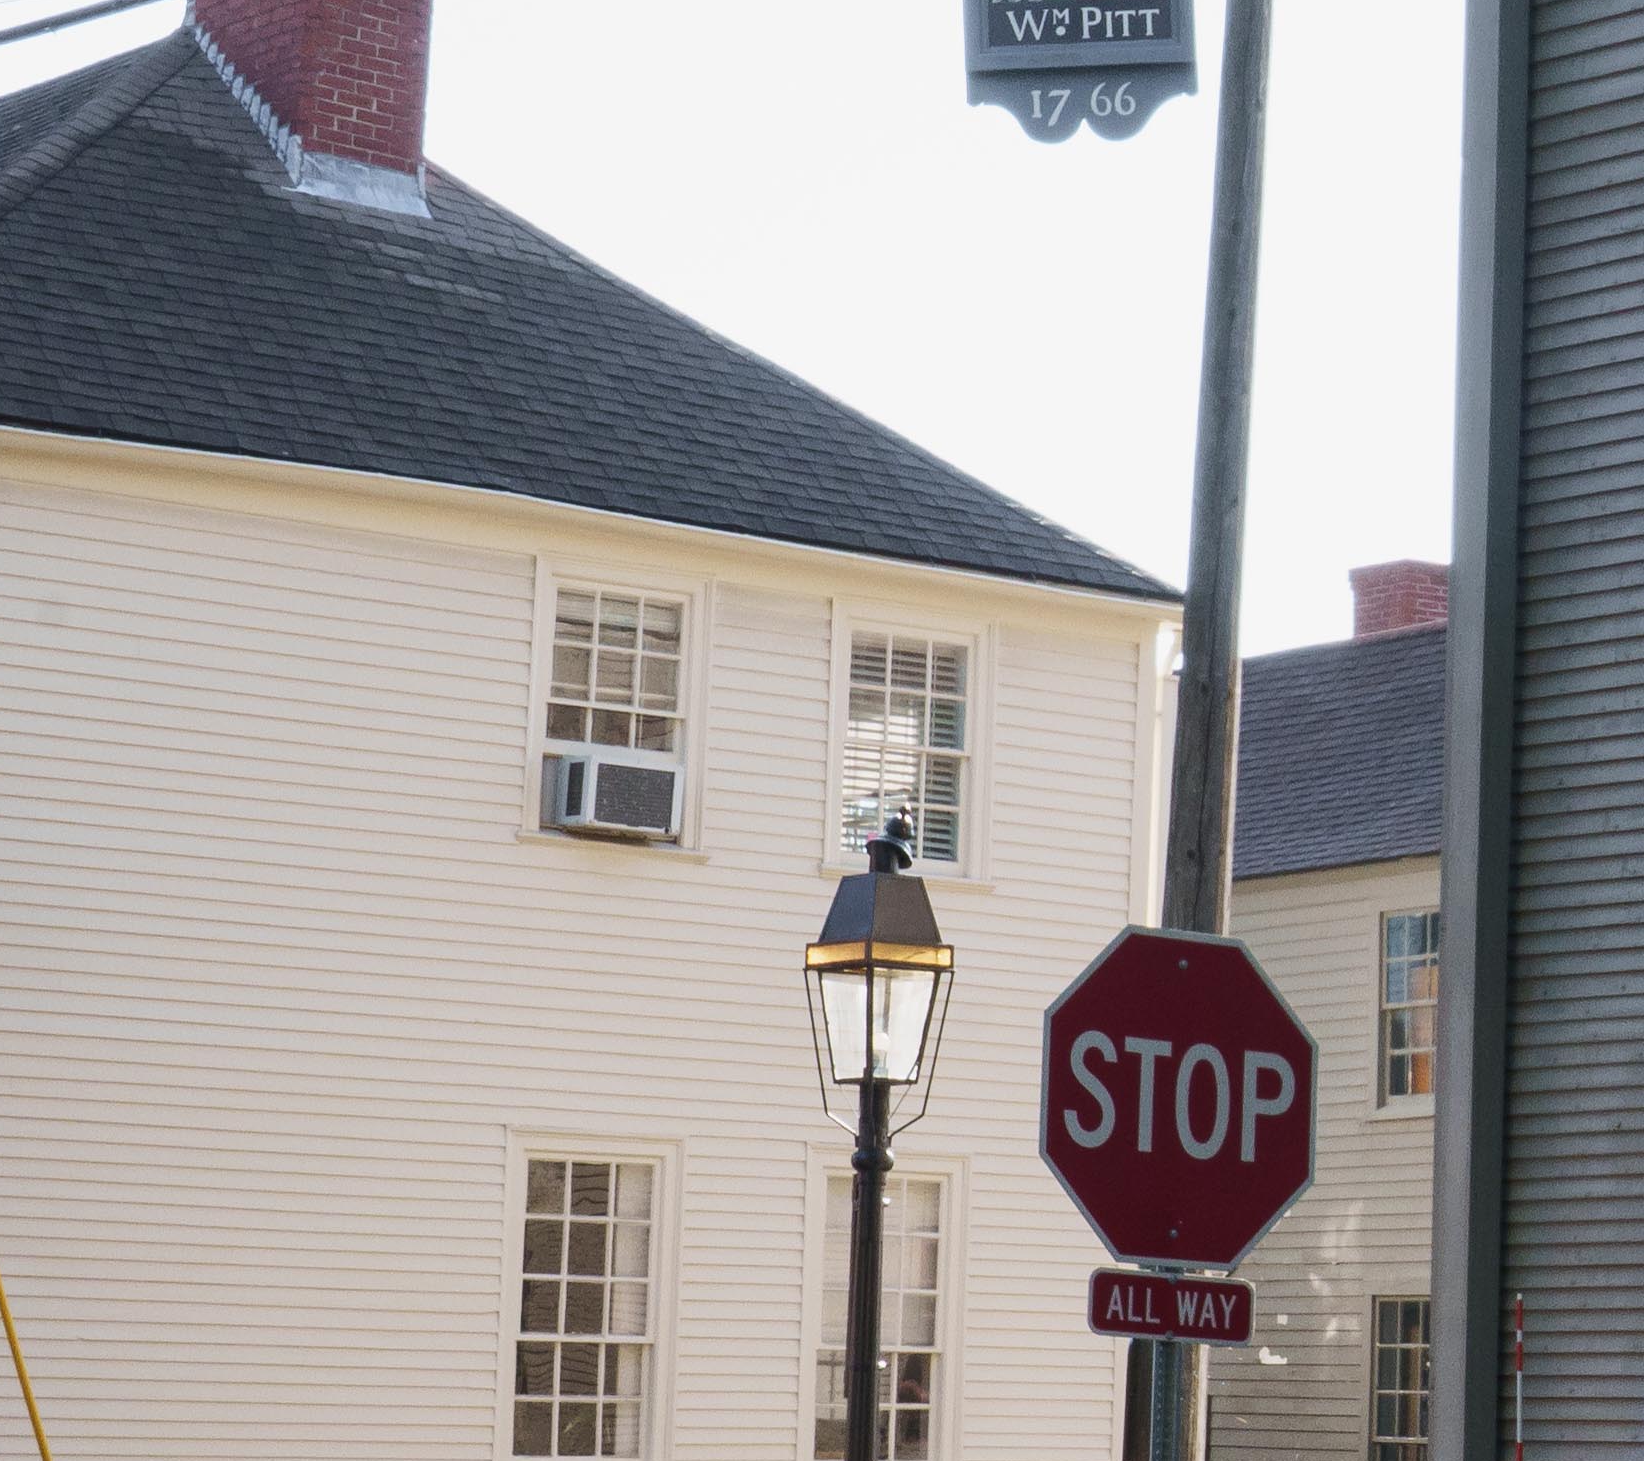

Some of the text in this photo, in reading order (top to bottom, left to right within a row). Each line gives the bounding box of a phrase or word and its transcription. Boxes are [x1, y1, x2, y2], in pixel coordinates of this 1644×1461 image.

[1081, 6, 1159, 40] PITT
[1063, 1030, 1296, 1163] STOP
[1106, 1284, 1237, 1330] ALL WAY
